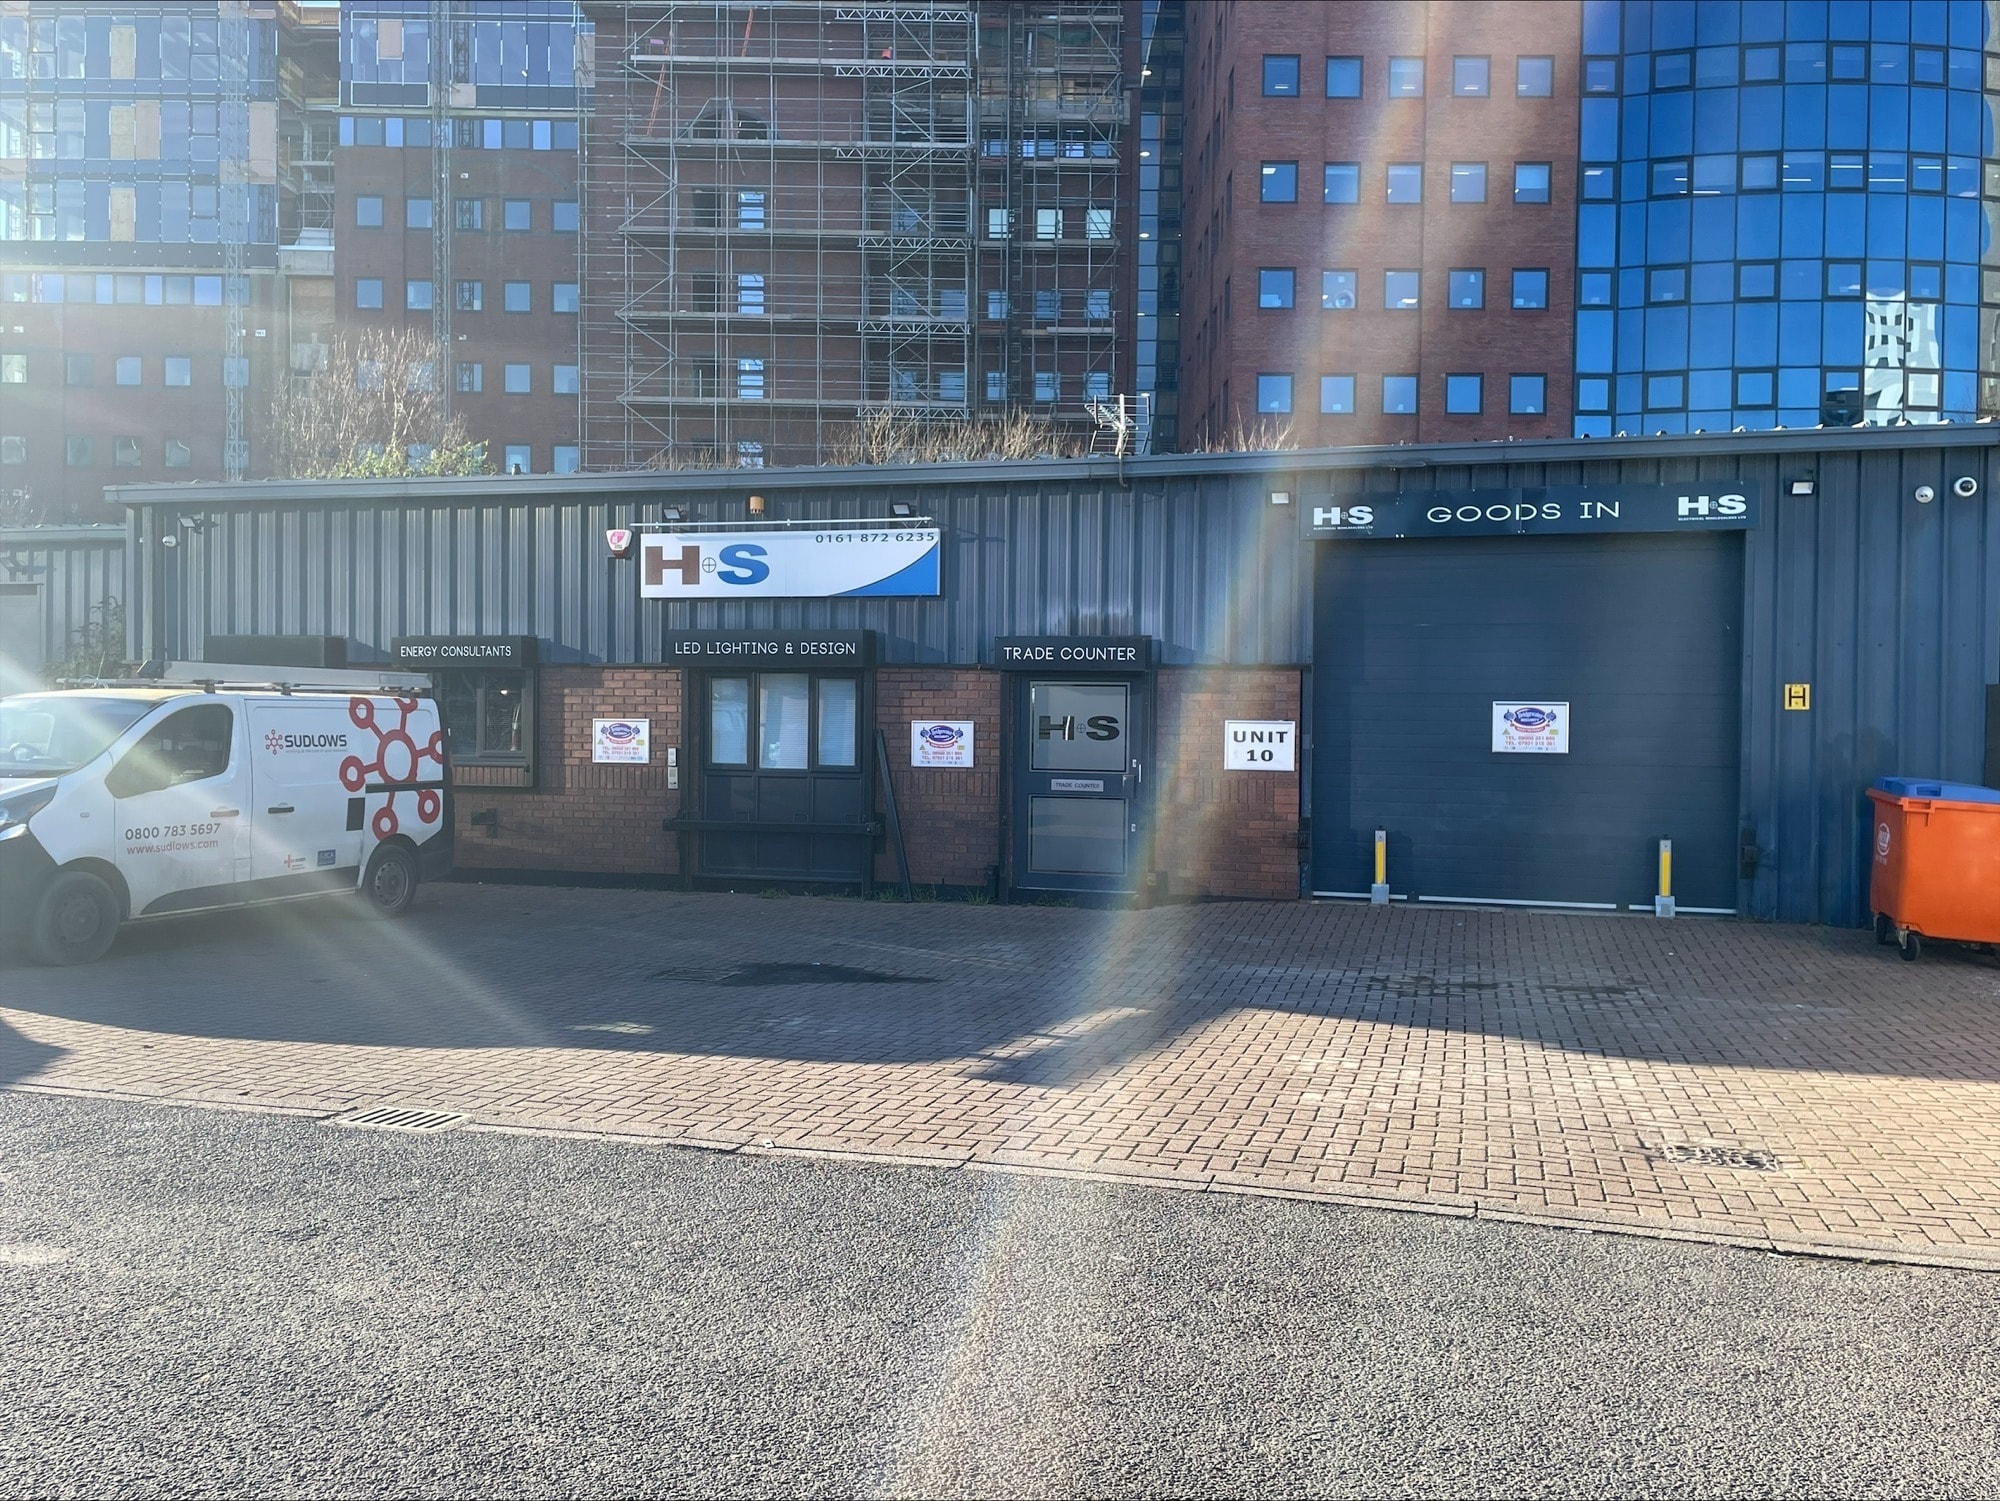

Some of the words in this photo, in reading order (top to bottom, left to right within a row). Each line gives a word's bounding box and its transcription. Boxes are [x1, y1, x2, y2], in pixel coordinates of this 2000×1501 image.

[1427, 503, 1562, 523] GOODS
[1580, 501, 1620, 519] IN
[815, 533, 852, 543] 0161
[860, 533, 889, 543] 872
[896, 532, 935, 542] 6235
[400, 646, 438, 657] ENERGY
[441, 645, 512, 657] CONSULTANTS
[675, 642, 701, 654] LED
[706, 642, 779, 654] LIGHTING
[785, 642, 794, 654] &
[800, 642, 856, 654] DESIGN
[1003, 647, 1055, 660] TRADE
[1060, 647, 1136, 660] COUNTER
[1788, 687, 1806, 707] H
[284, 734, 347, 748] SUDLOWS
[1233, 731, 1288, 743] UNIT
[1247, 749, 1273, 762] 10
[125, 827, 159, 840] 0800
[164, 825, 186, 837] 783
[190, 823, 221, 835] 5697
[126, 840, 219, 855] www.sudlows.com
